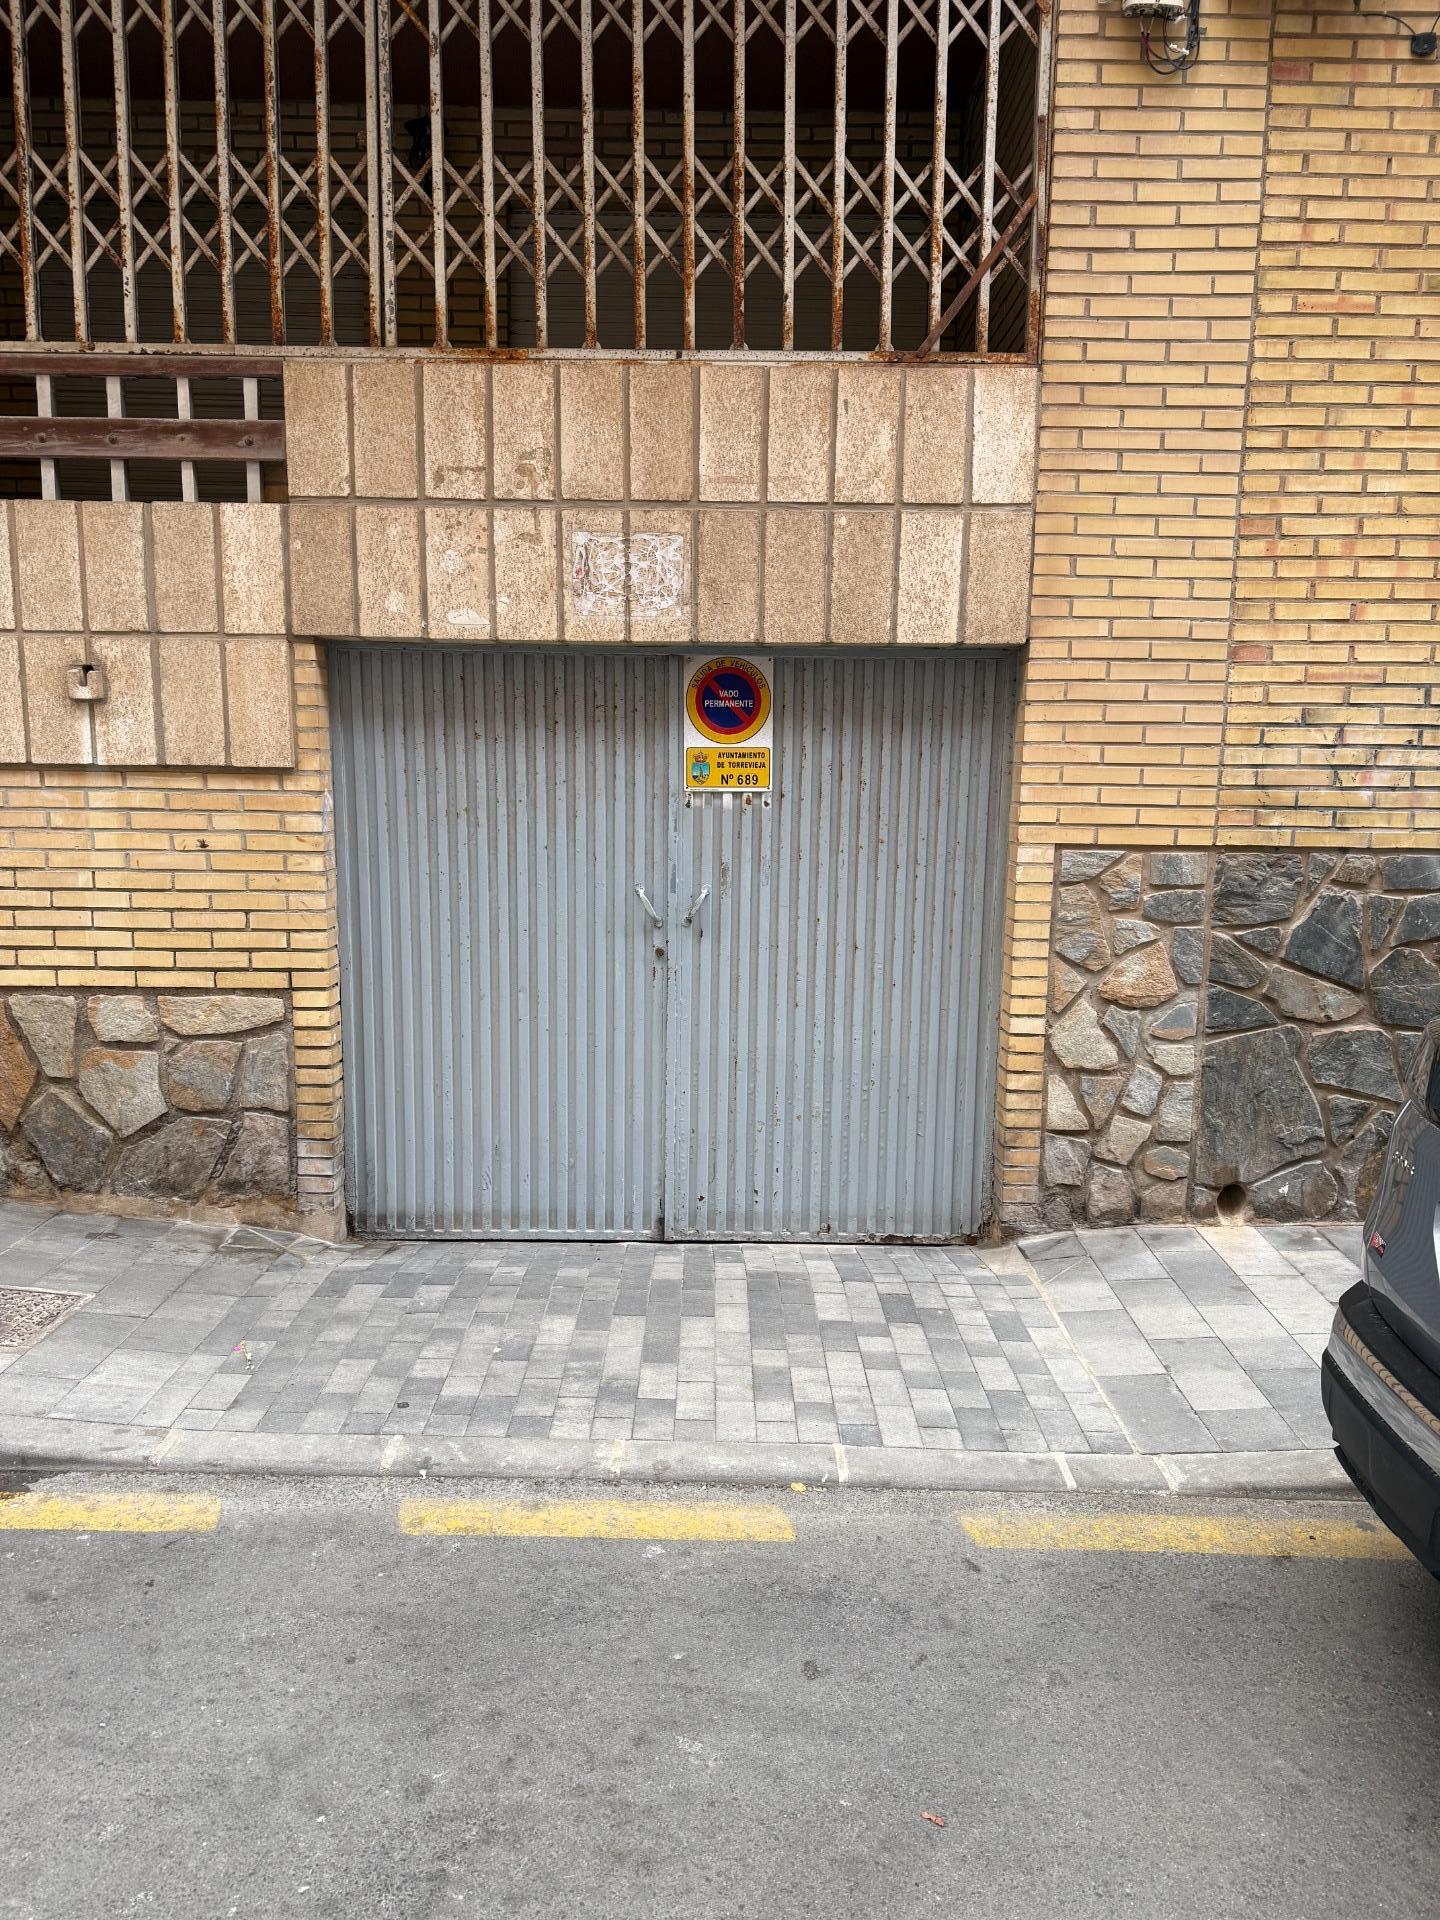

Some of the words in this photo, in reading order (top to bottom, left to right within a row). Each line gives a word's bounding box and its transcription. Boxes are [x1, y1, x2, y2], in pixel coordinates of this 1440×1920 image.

[692, 665, 713, 689] SALIDA
[715, 659, 726, 669] DE
[719, 690, 739, 698] VADO
[704, 699, 754, 708] PERMANENTE
[737, 774, 759, 785] 689
